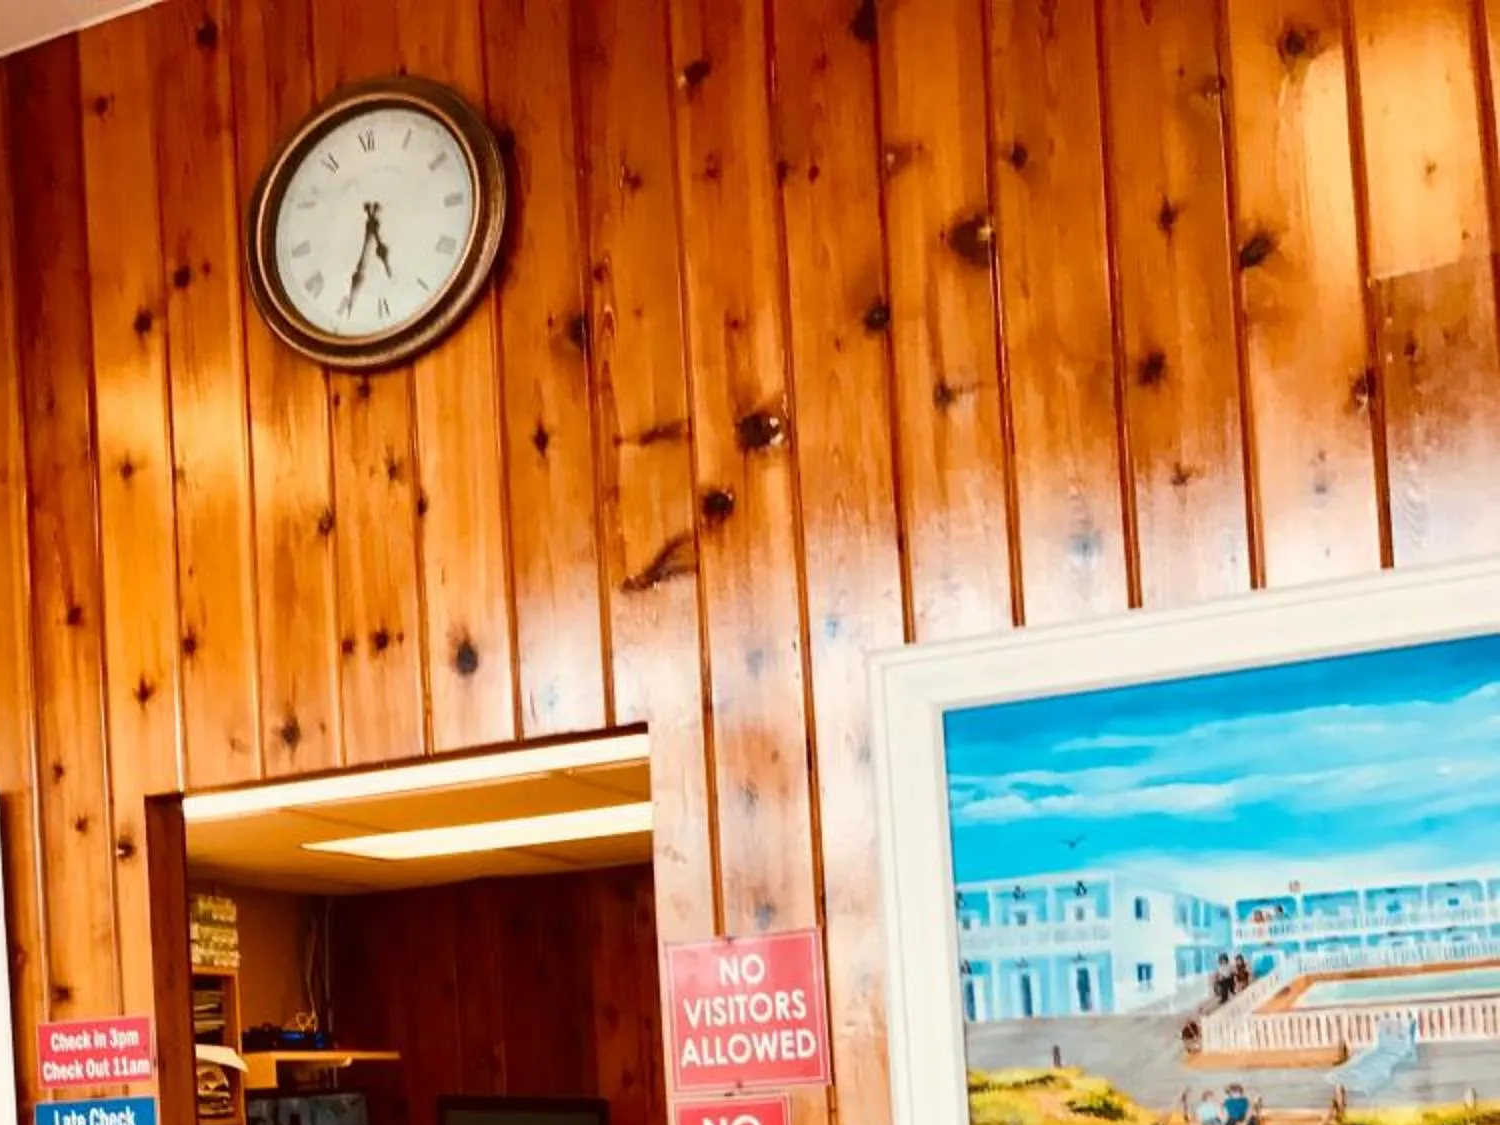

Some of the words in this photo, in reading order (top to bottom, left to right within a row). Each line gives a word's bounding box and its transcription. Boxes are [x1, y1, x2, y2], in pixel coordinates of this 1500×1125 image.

[718, 954, 765, 986] NO
[683, 989, 807, 1029] VISITORS
[50, 1029, 92, 1052] Check
[109, 1027, 139, 1050] 3pm
[681, 1029, 817, 1069] ALLOWED
[42, 1059, 83, 1082] Check
[86, 1057, 110, 1078] Out
[113, 1056, 151, 1076] 11am
